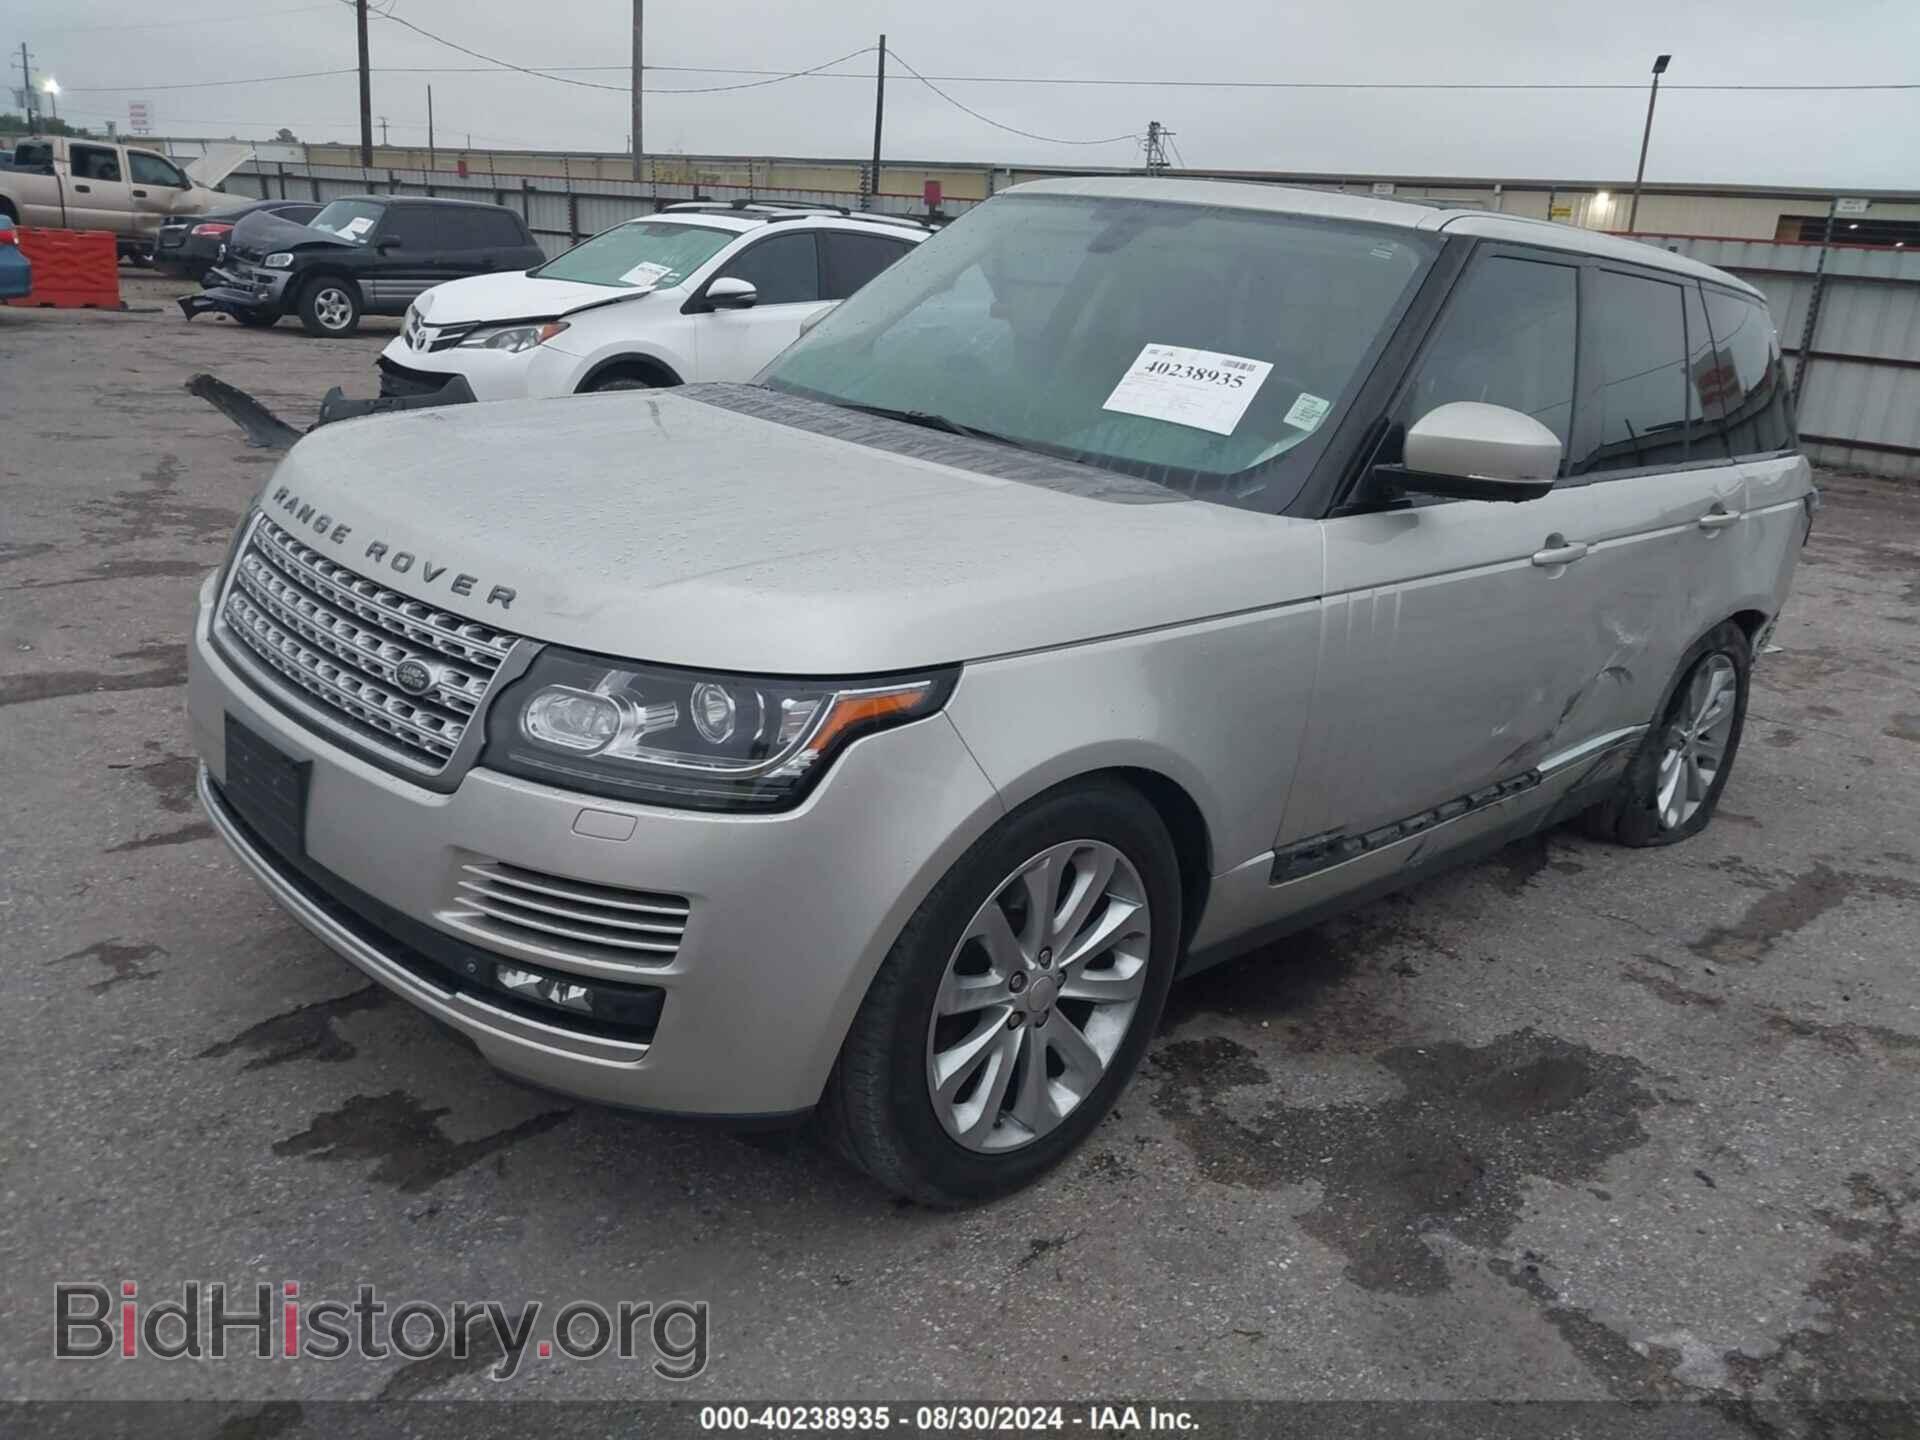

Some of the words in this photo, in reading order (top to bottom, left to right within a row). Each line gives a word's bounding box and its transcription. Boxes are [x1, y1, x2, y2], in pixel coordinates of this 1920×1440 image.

[1143, 360, 1246, 389] 40238935
[273, 486, 352, 544] RANGE
[365, 541, 517, 609] ROVER
